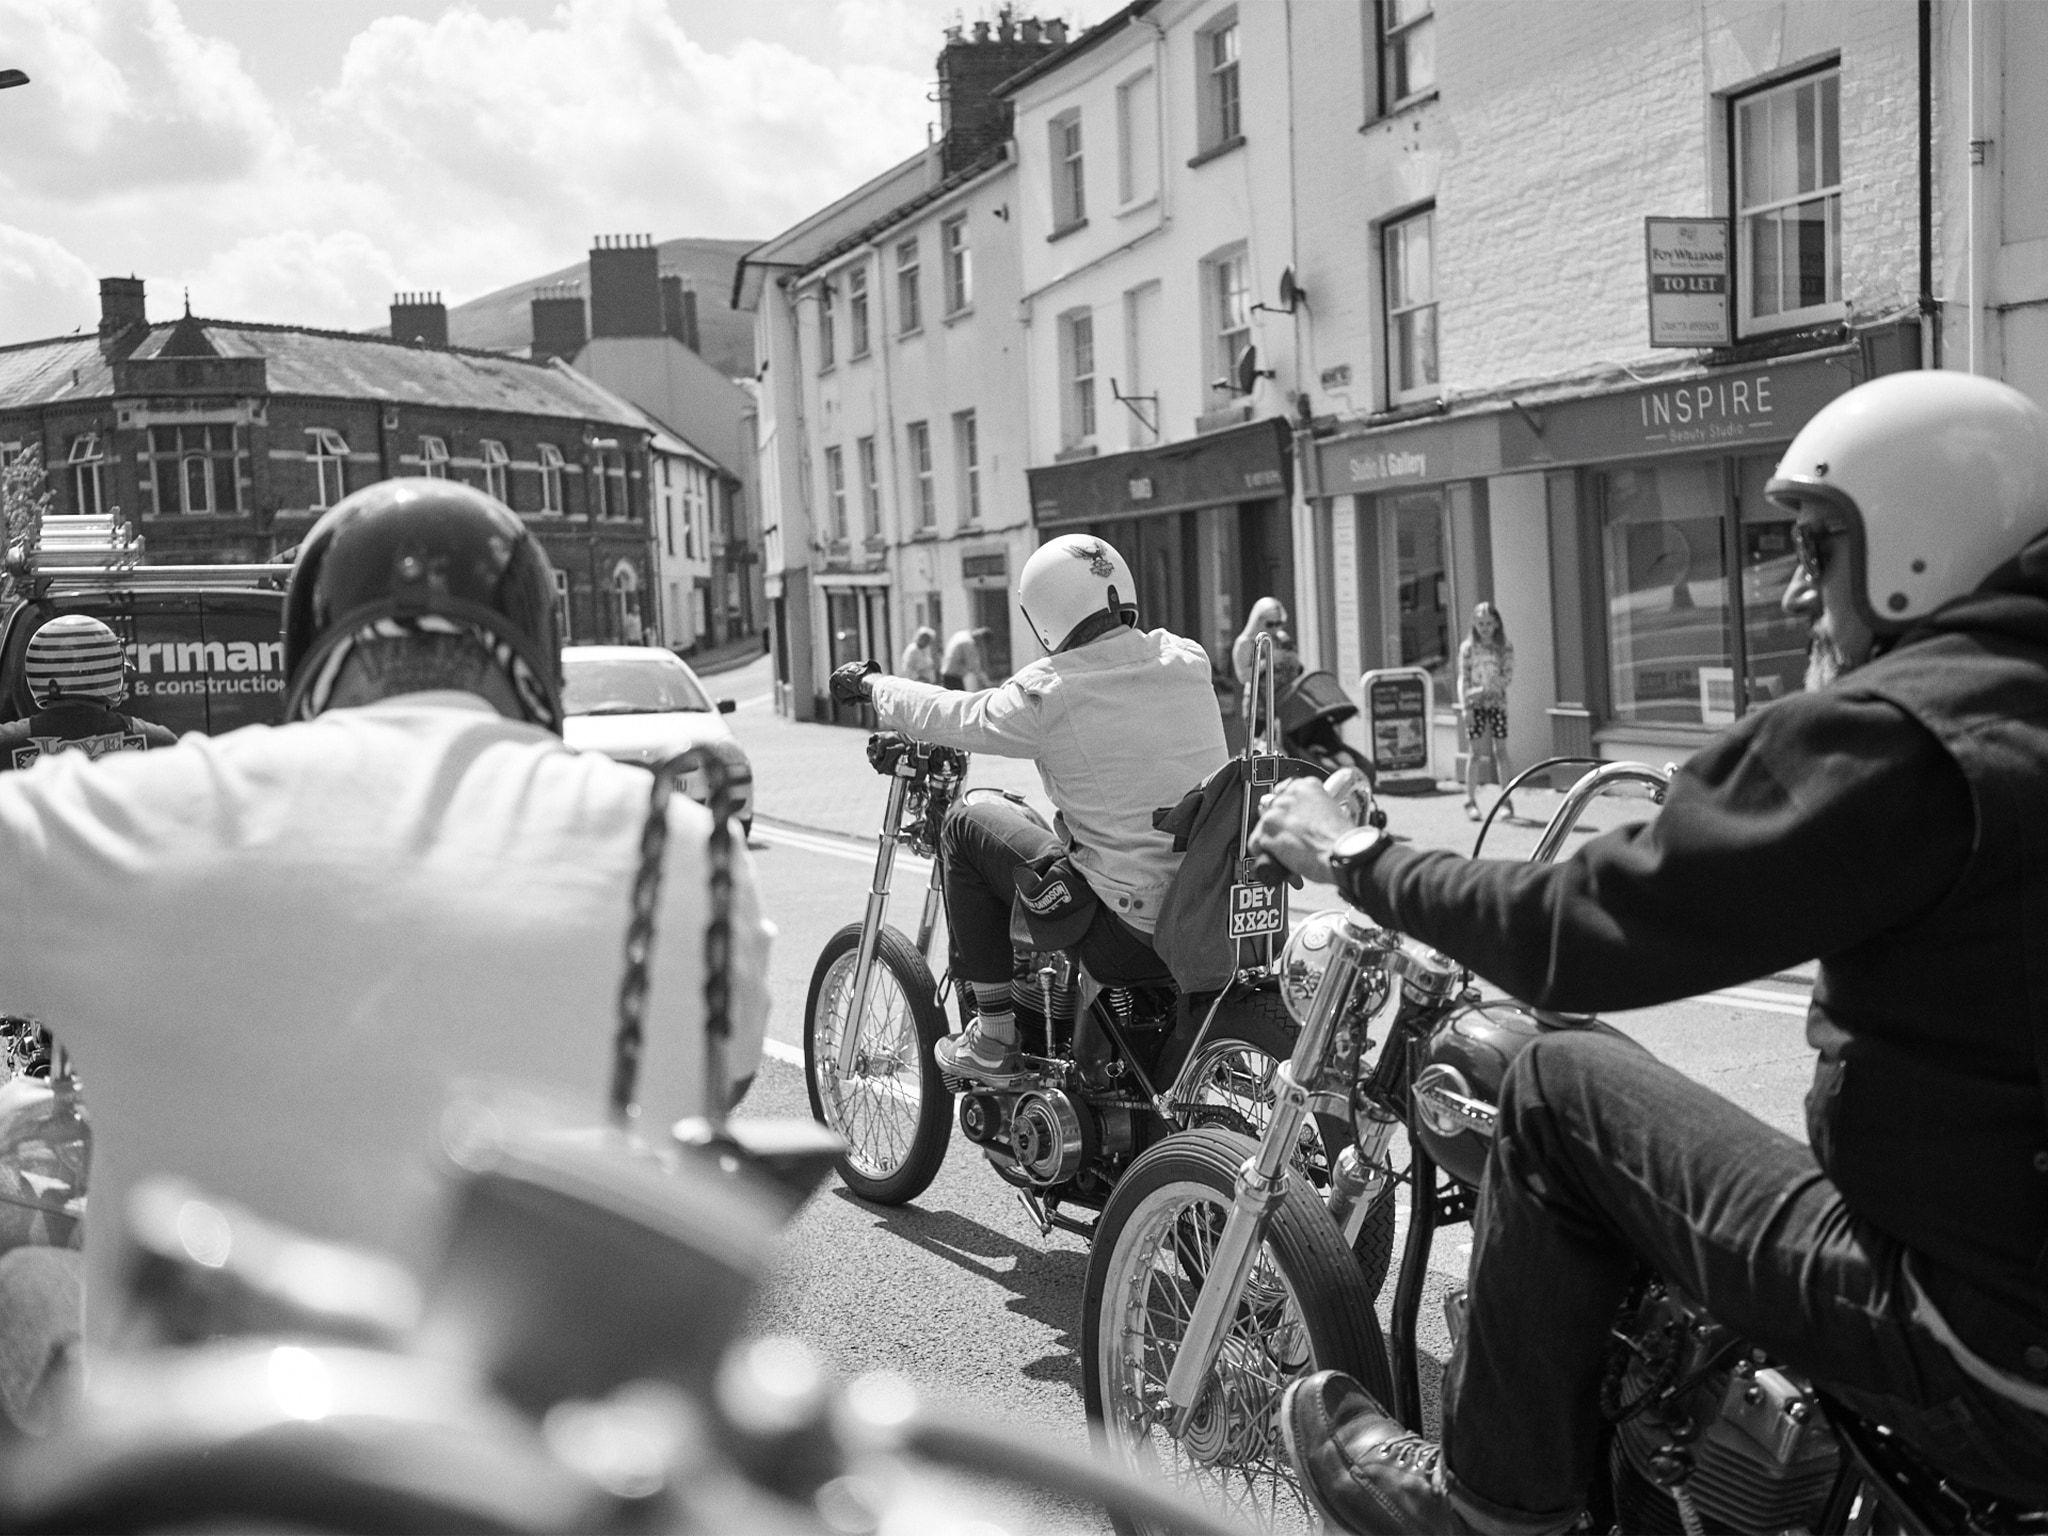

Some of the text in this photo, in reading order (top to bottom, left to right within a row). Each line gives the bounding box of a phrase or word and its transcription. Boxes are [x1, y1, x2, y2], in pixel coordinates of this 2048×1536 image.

[1661, 277, 1717, 291] TO LET
[1641, 376, 1773, 426] INSPIRE
[1709, 422, 1744, 438] Studio
[1387, 451, 1426, 477] Gallery
[135, 681, 149, 695] &
[1239, 886, 1276, 910] DEY
